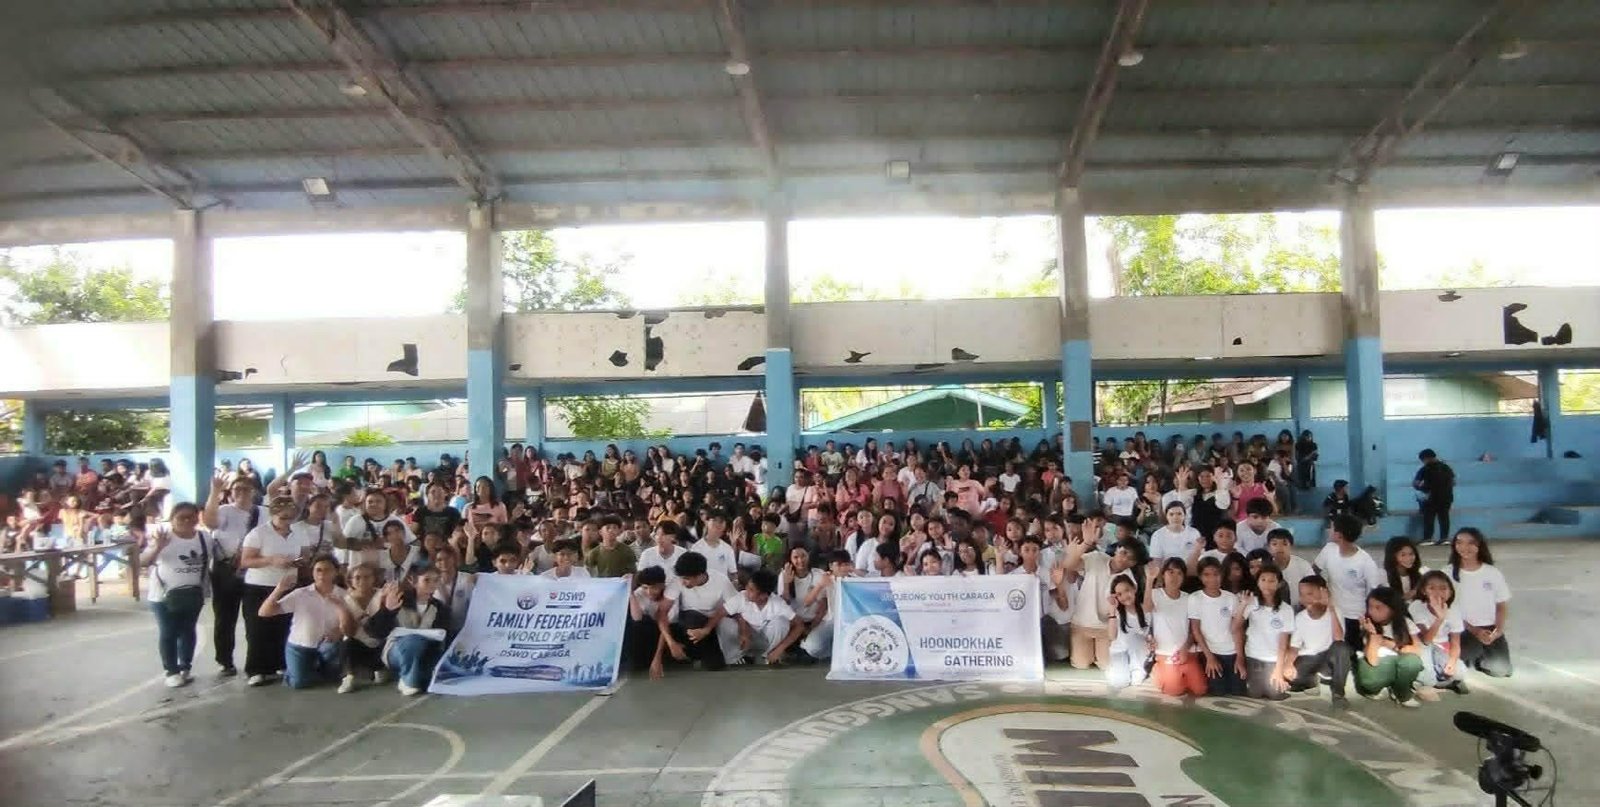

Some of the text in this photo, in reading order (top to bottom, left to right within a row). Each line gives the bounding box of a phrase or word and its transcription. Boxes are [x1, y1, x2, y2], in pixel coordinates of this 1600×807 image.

[558, 591, 586, 601] DSWD
[928, 592, 958, 601] YOUTH
[960, 591, 996, 601] CARAGA
[486, 611, 606, 630] FAMILY FEDERATION
[507, 630, 551, 642] WORLD
[553, 629, 591, 642] PEACE
[920, 637, 1003, 649] HOONDOKHAE
[944, 655, 1014, 667] GATHERING
